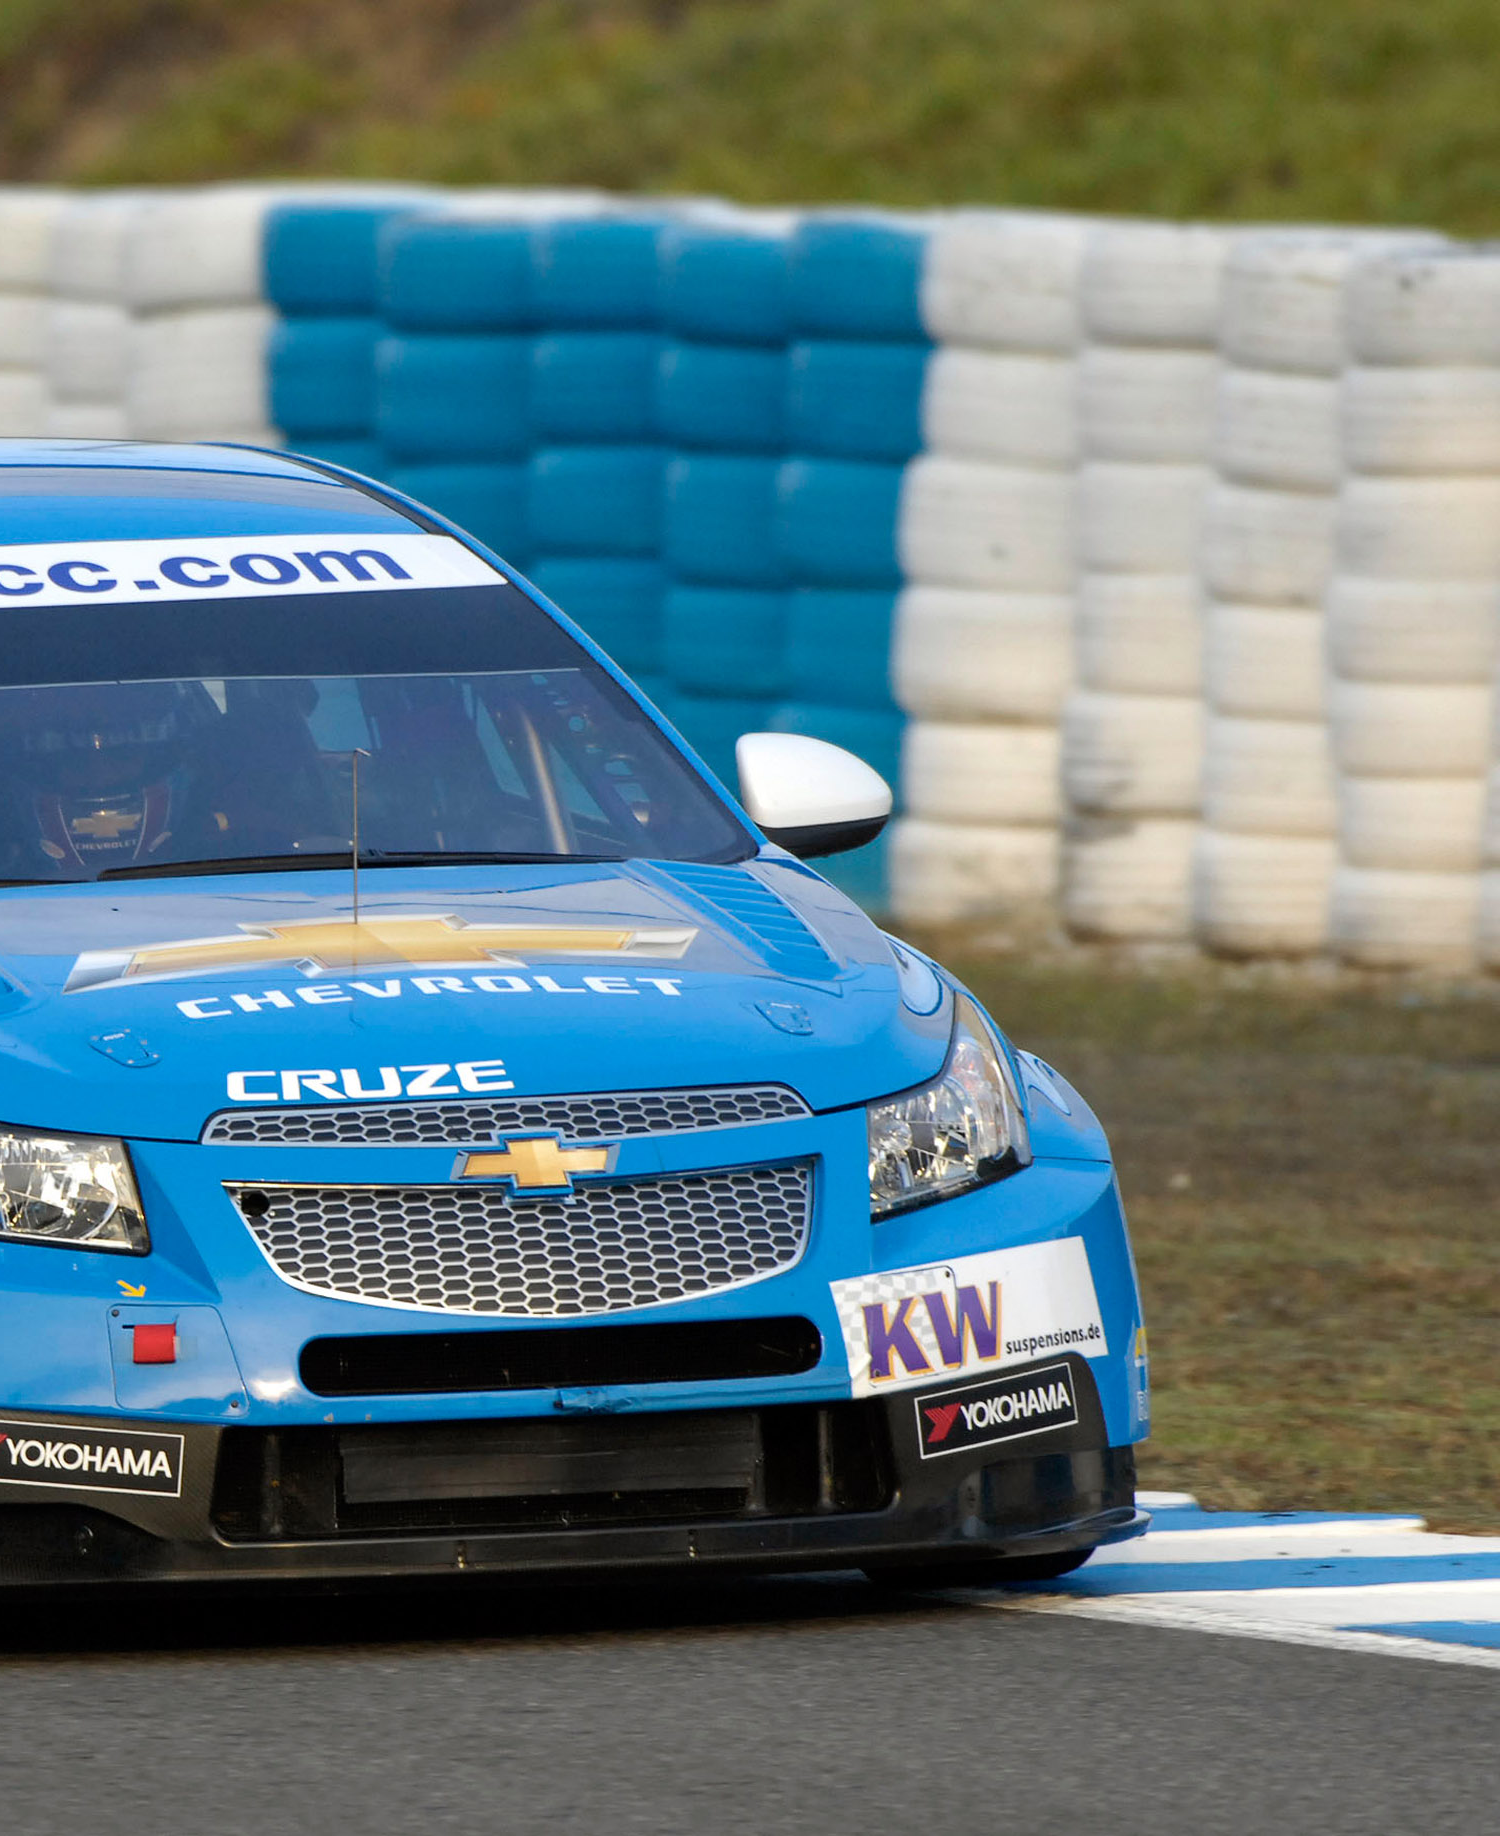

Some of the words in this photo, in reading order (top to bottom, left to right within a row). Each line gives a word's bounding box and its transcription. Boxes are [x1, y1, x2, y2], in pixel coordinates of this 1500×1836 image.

[75, 838, 139, 850] CHEVROLET
[176, 975, 684, 1019] CHEVROLET
[226, 1059, 515, 1101] CRUZE
[861, 1280, 1002, 1383] KW
[1005, 1323, 1101, 1356] suspensions.de
[960, 1381, 1072, 1431] YOKOHAMA
[5, 1438, 173, 1479] YOKOHAMA
